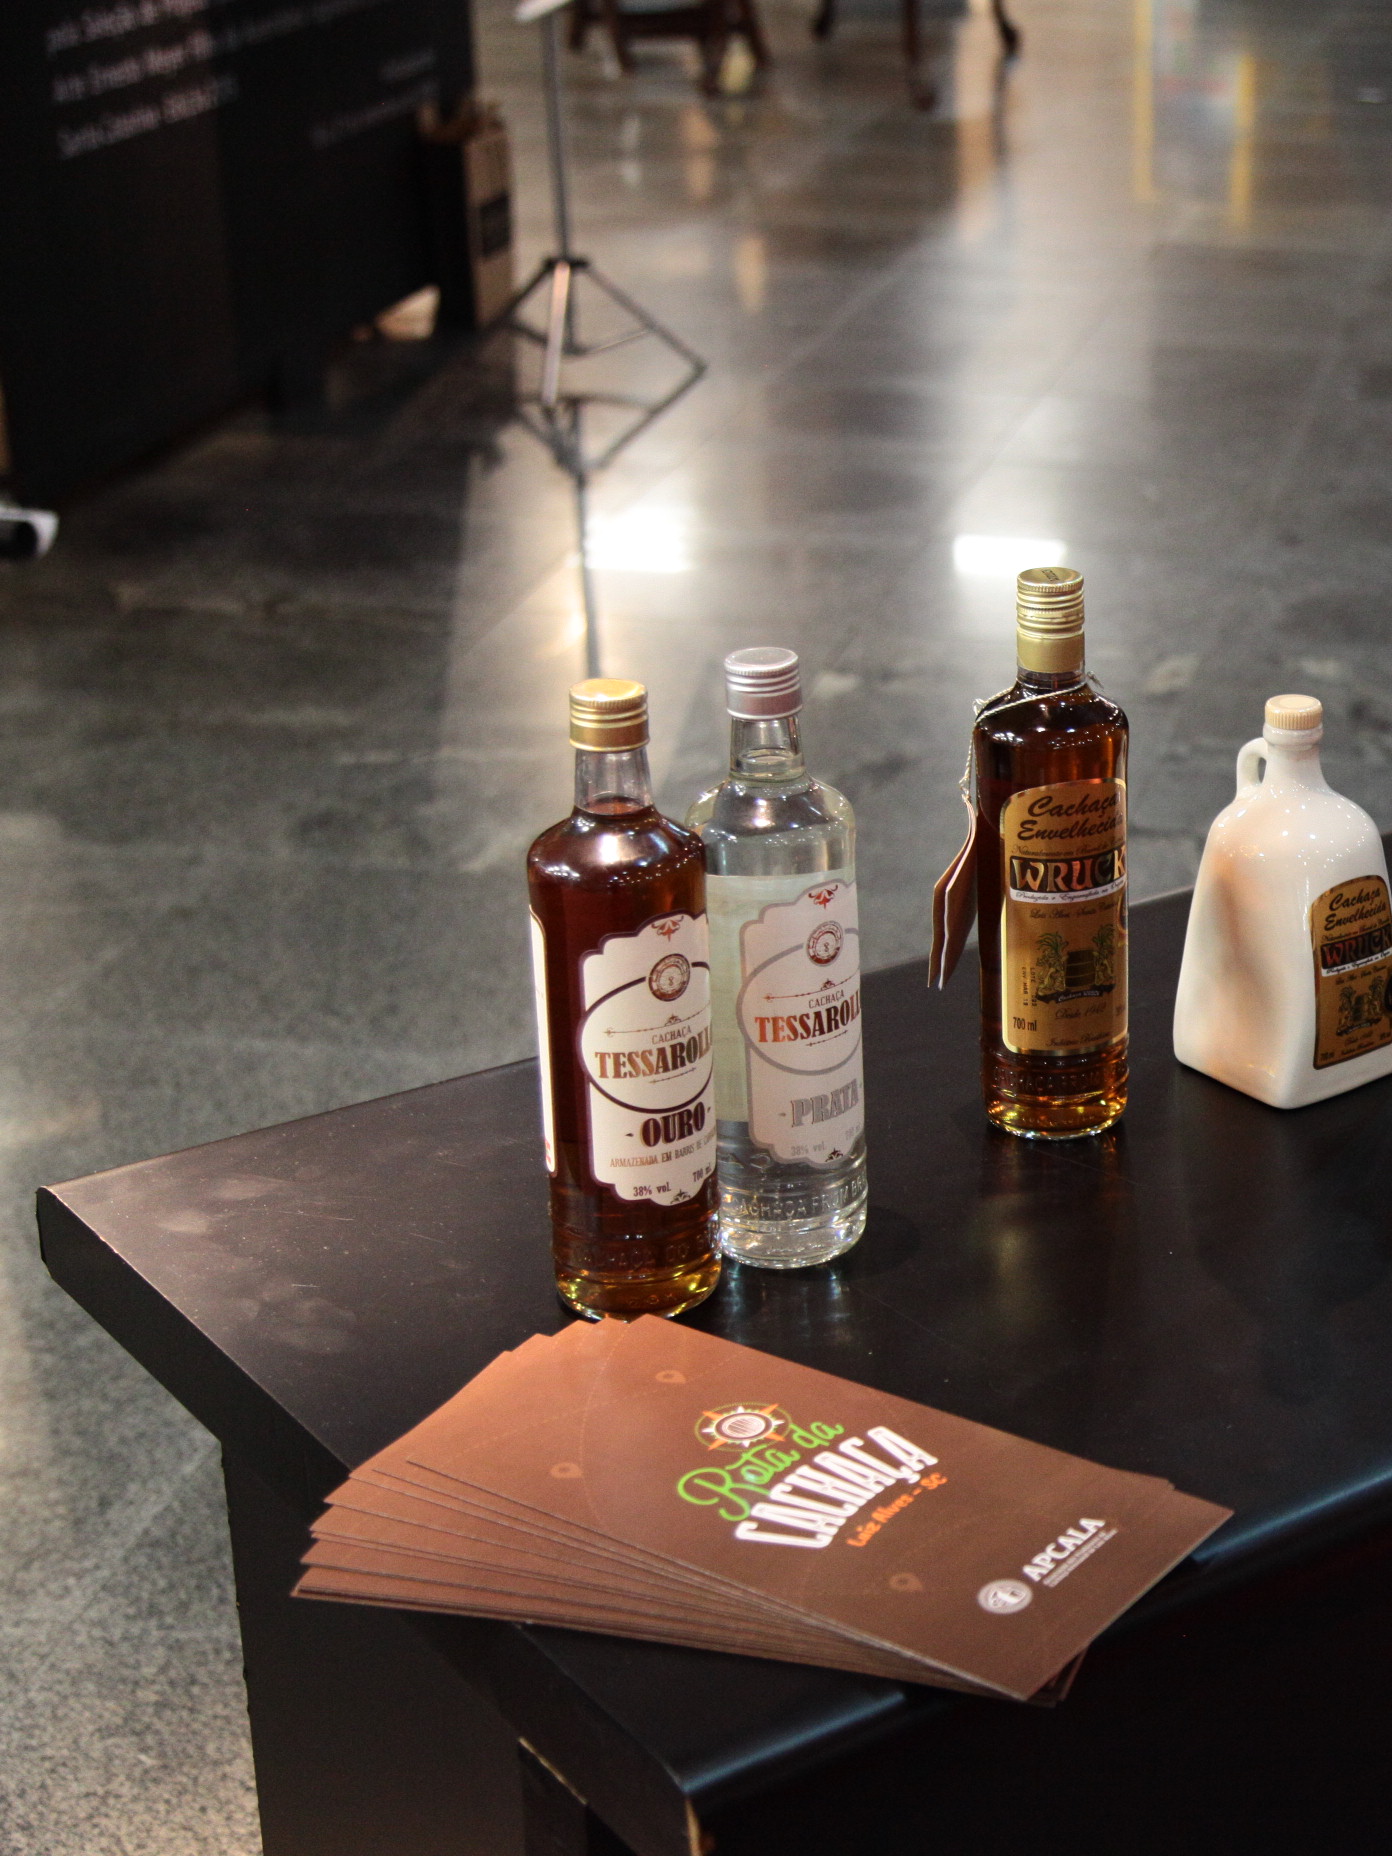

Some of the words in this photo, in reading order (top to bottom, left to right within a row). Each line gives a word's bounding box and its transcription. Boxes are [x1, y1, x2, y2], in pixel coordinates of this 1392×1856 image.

[1028, 793, 1117, 819] Cachaça
[1012, 845, 1126, 892] WRUCK
[1329, 888, 1381, 911] Cachaça
[1323, 926, 1392, 966] WRUCK
[755, 988, 860, 1043] TESSAROLL
[808, 989, 845, 1009] CACHAÇA
[652, 1025, 692, 1045] CACHAÇA
[1013, 1016, 1026, 1030] 700
[1027, 1019, 1037, 1031] ml
[595, 1025, 711, 1079] TESSAROLL
[640, 1101, 706, 1148] OURO
[790, 1078, 859, 1128] PRATA
[610, 1155, 659, 1168] ARMAZENADA
[661, 1151, 672, 1162] EM
[675, 1143, 695, 1160] BARRIS
[790, 1144, 809, 1157] 38%
[633, 1186, 653, 1197] 38%
[677, 1443, 801, 1521] Rota
[790, 1421, 845, 1449] da
[735, 1425, 939, 1548] CACHAÇA
[871, 1492, 914, 1523] Alves
[920, 1472, 948, 1491] SC
[1022, 1517, 1106, 1582] APCALA
